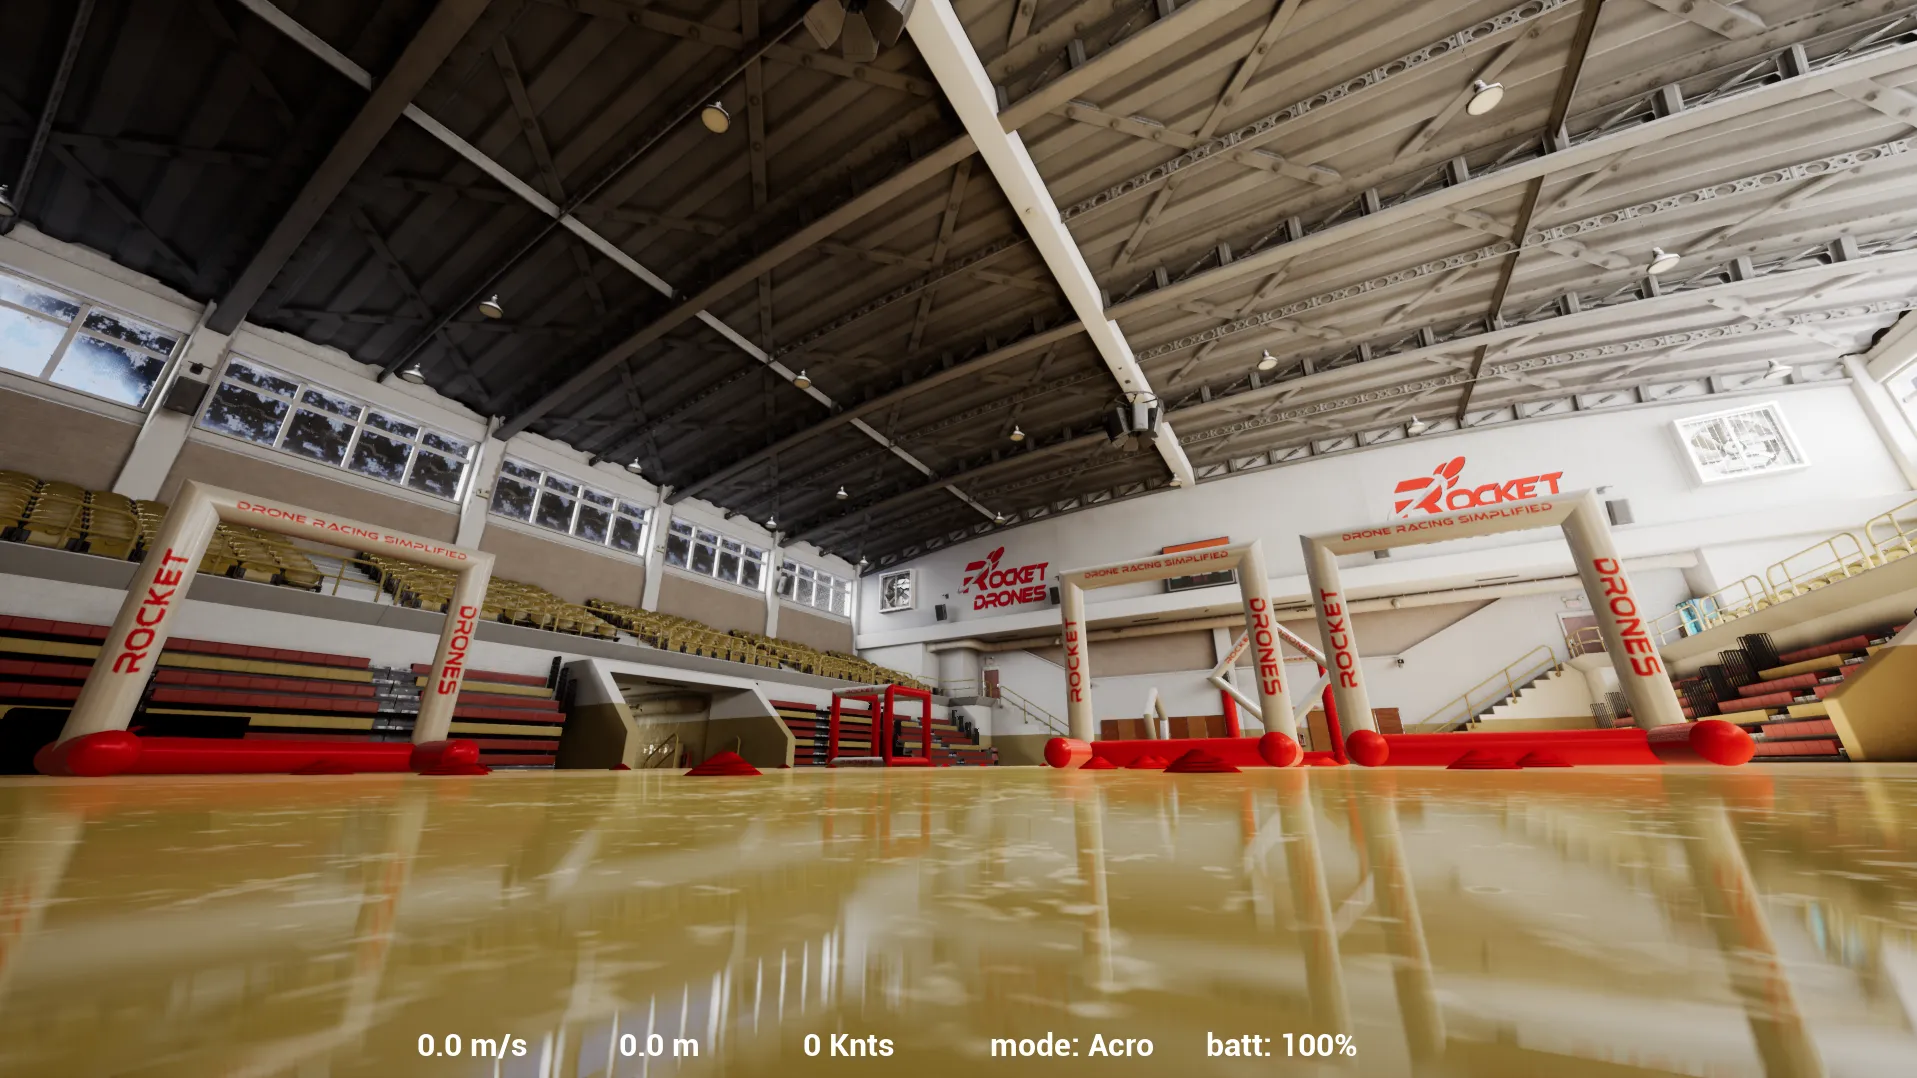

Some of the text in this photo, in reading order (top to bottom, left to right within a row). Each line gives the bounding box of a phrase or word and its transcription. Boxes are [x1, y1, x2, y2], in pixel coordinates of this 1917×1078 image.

[1394, 456, 1563, 519] ROCKET
[237, 501, 468, 561] DRONE RACING SIMPLIFIED
[1342, 502, 1553, 542] DRONE RACING SIMPLIFIED
[962, 546, 1049, 595] ROCKET
[1084, 550, 1229, 579] DRONE RACING SIMPLIFIED
[113, 547, 190, 676] ROCKET
[973, 584, 1047, 611] DRONES
[1592, 556, 1662, 678] DRONES
[437, 605, 478, 697] DRONES
[1065, 617, 1083, 704] ROCKET
[1225, 634, 1249, 664] ROCKE
[1249, 597, 1283, 697] DRONES
[1321, 588, 1358, 689] ROCKET
